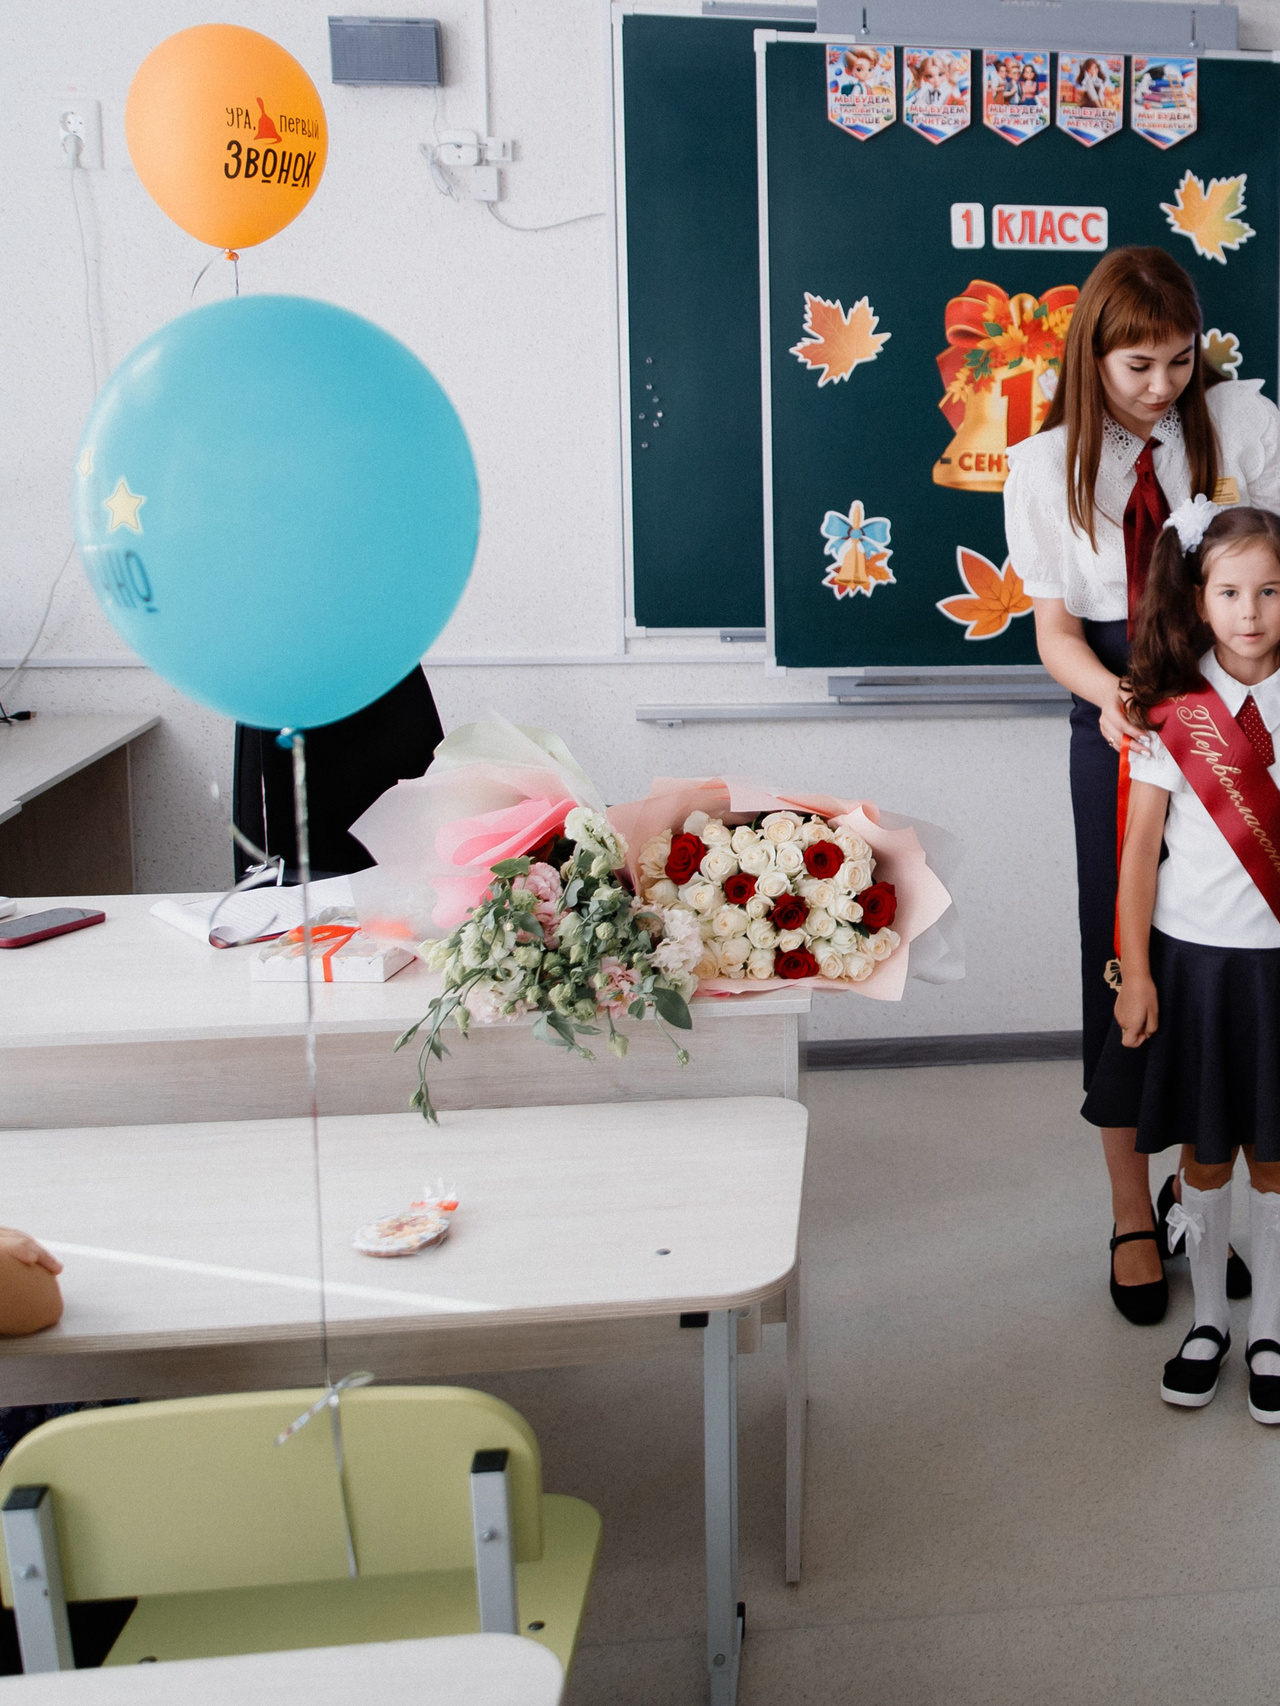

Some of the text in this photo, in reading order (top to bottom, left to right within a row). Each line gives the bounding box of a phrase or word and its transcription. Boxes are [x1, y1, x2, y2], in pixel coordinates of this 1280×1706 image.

[834, 96, 890, 104] МЫ БУДЕМ
[910, 105, 965, 115] МЫ БУДЕМ
[989, 105, 1044, 115] МЫ БУДЕМ
[1062, 108, 1116, 118] МЫ БУДЕМ
[844, 116, 881, 124] ЛУЧШЕ
[224, 139, 317, 188] ЗВОНОК
[961, 208, 1104, 244] 1 КЛАСС
[1001, 370, 1034, 447] 1
[959, 452, 1010, 472] СЕН
